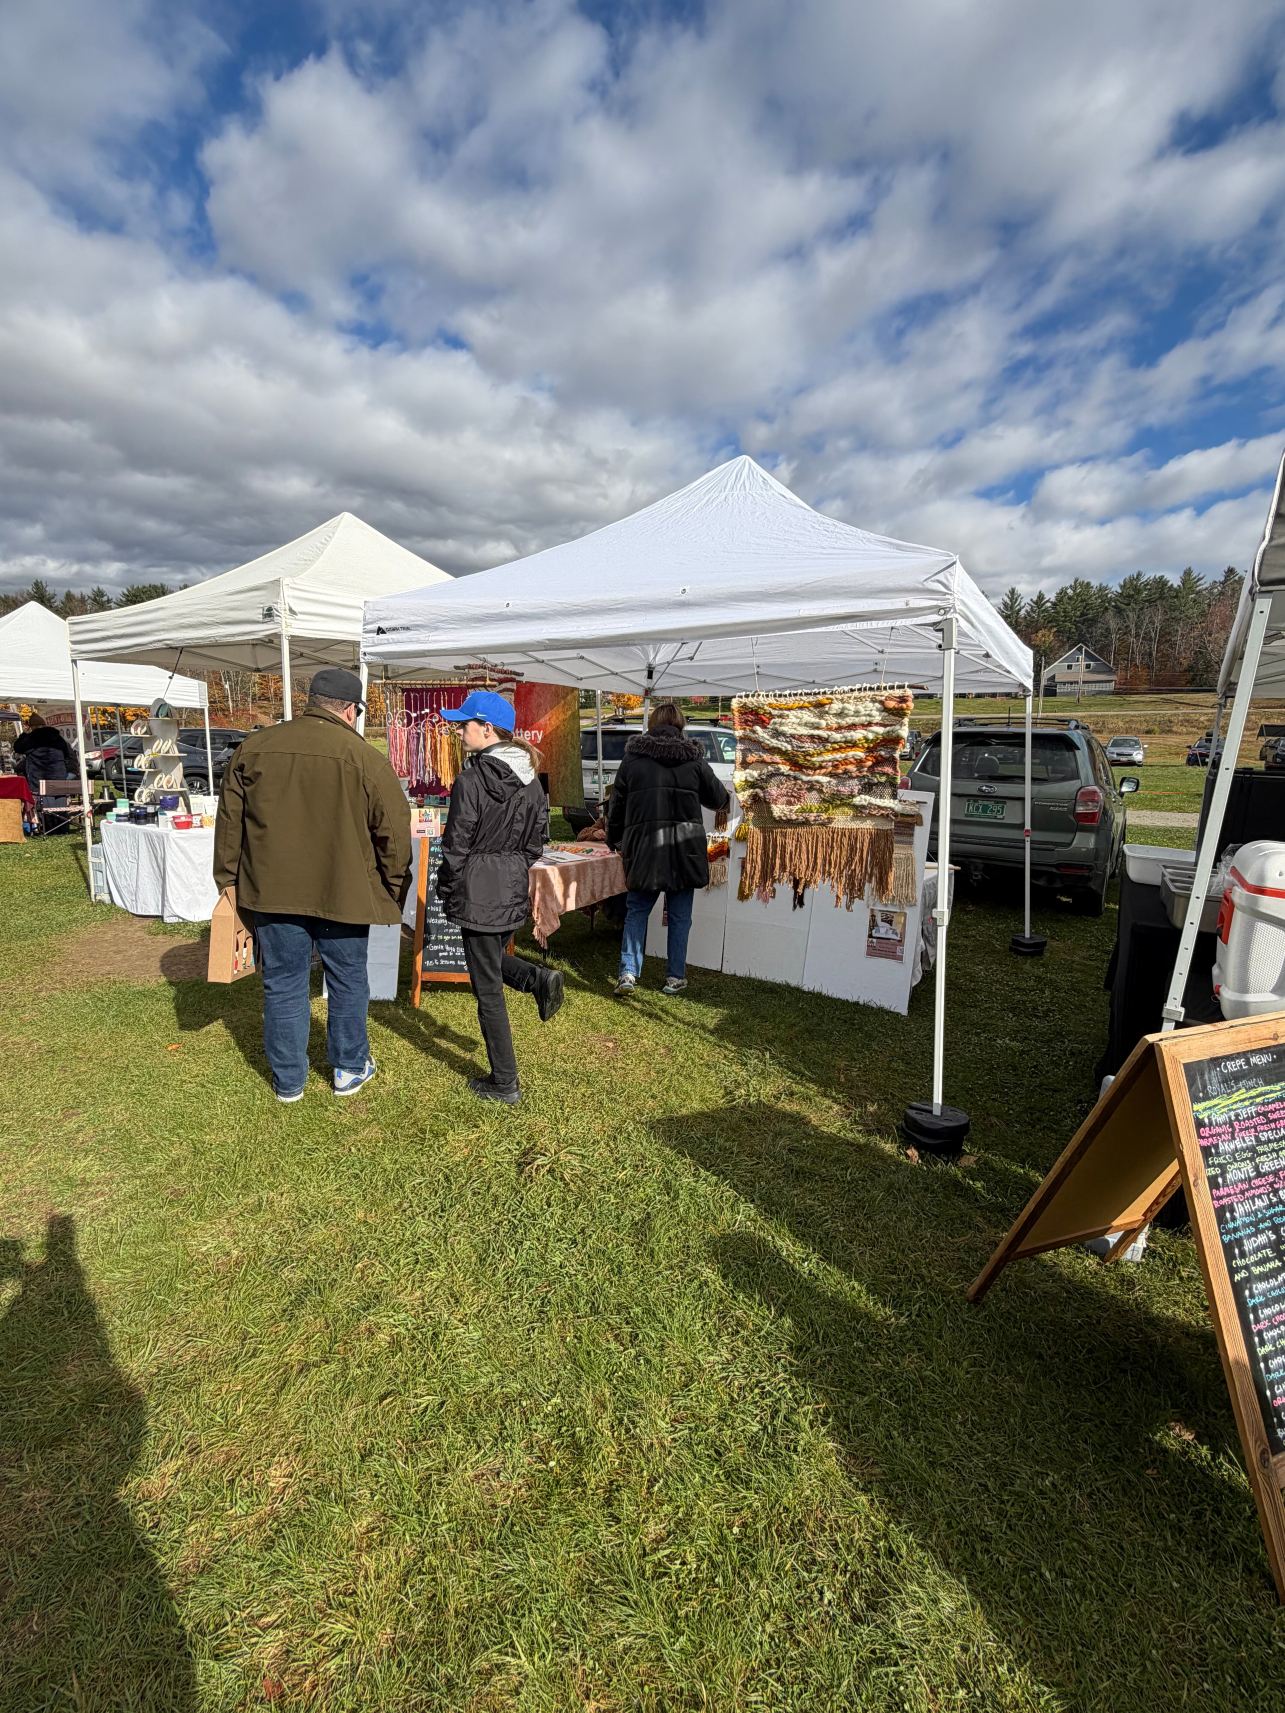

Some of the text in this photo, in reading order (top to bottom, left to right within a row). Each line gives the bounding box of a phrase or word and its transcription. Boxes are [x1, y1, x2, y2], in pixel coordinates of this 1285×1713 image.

[1221, 1053, 1272, 1073] CREPE MENU
[1233, 1116, 1267, 1132] ROASTED
[1233, 1248, 1276, 1268] CHOCOLATE
